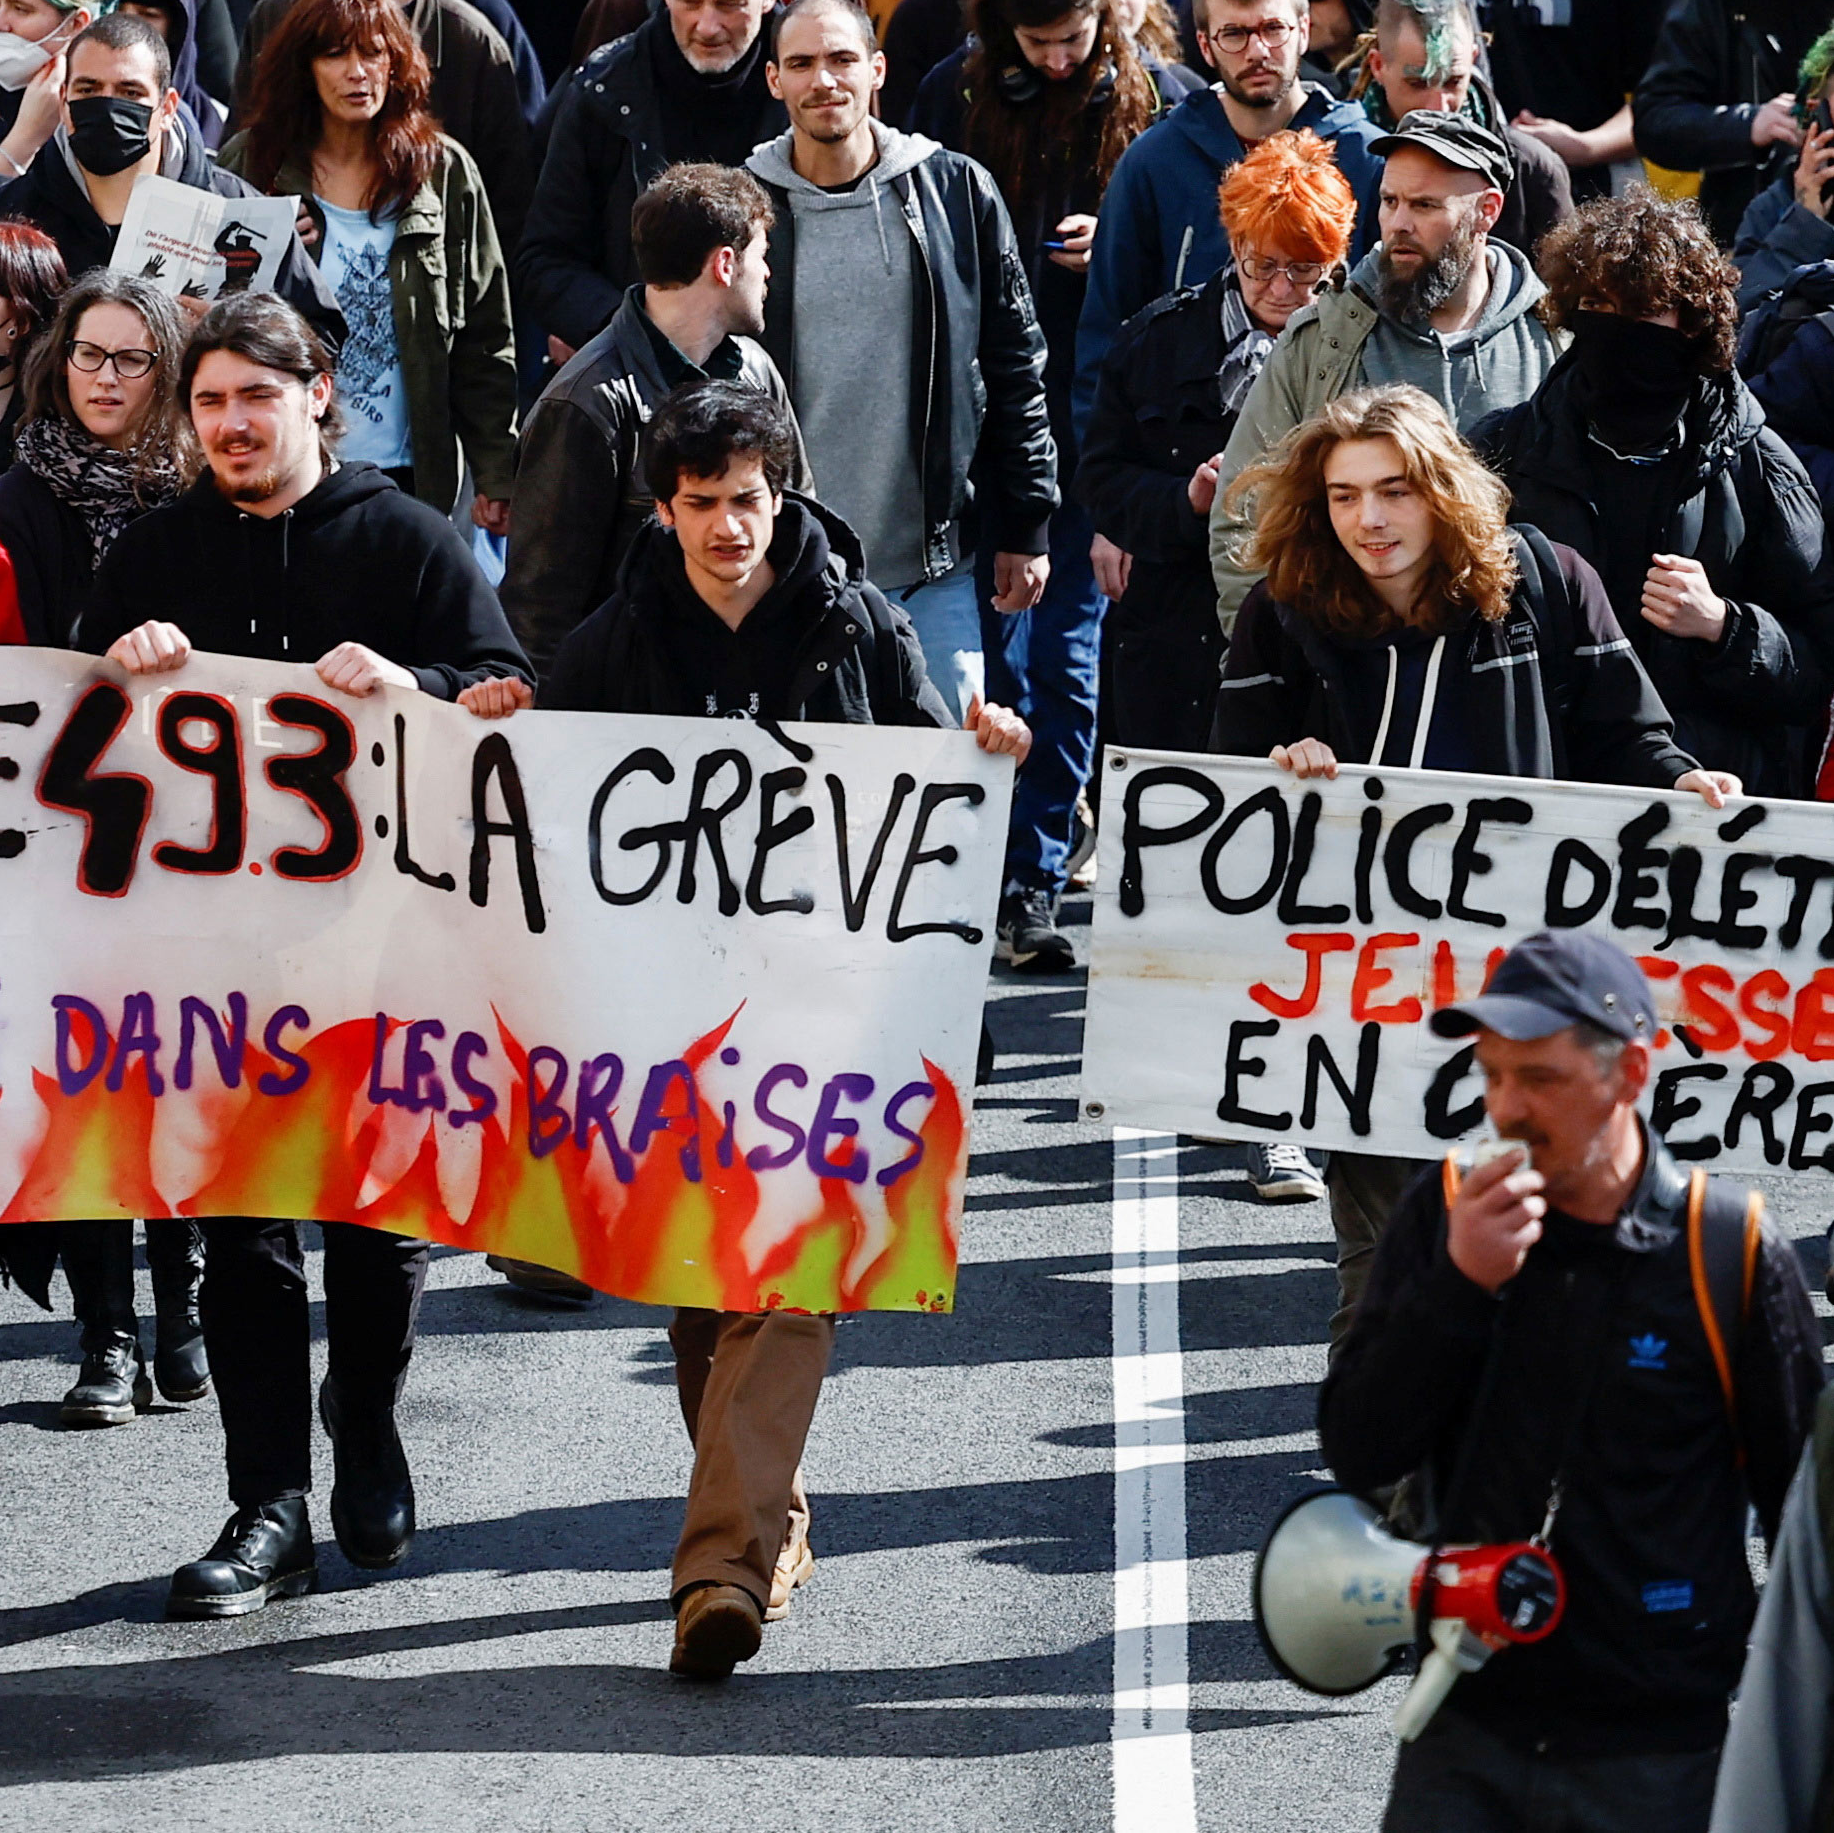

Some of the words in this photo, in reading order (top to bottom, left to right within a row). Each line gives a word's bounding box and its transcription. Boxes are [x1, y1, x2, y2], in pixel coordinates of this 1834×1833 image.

[350, 395, 383, 424] BIRD
[588, 719, 986, 946] GRÈVE
[51, 991, 312, 1097] DANS
[367, 1011, 497, 1129] LES
[1217, 1020, 1382, 1136] EN
